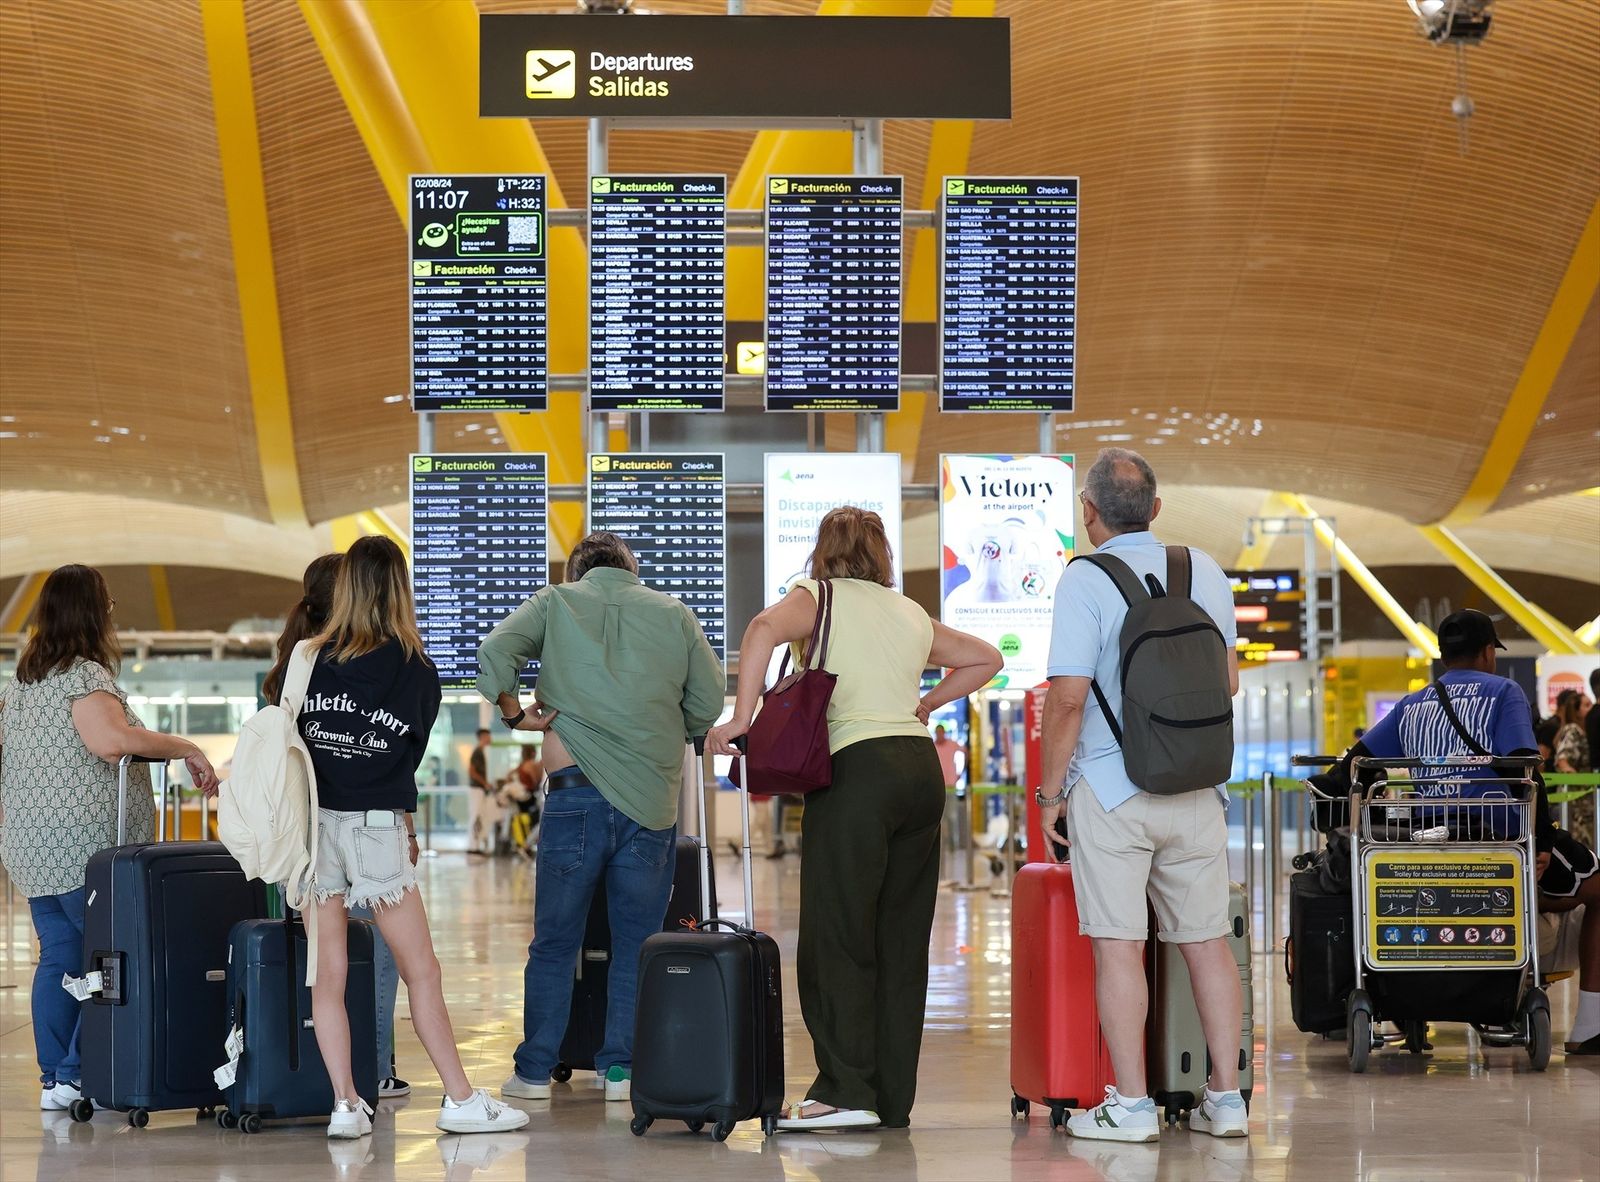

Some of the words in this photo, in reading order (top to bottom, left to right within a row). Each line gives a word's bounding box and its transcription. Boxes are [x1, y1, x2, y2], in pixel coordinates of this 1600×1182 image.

[590, 52, 694, 74] Departures
[589, 76, 669, 96] Salidas
[613, 182, 674, 192] Facturación
[791, 183, 851, 193] Facturación
[968, 184, 1027, 194] Facturación
[1037, 186, 1068, 194] Check-in
[415, 191, 469, 209] 11:07
[434, 265, 495, 274] Facturación
[435, 461, 495, 470] Facturación
[613, 460, 672, 470] Facturación
[960, 474, 1053, 504] Victory
[1008, 503, 1034, 511] airport
[778, 516, 818, 528] invisi
[1464, 682, 1481, 696] BE
[302, 692, 357, 714] hletic
[360, 708, 411, 737] port
[305, 720, 354, 744] Brownie
[360, 731, 388, 750] Club
